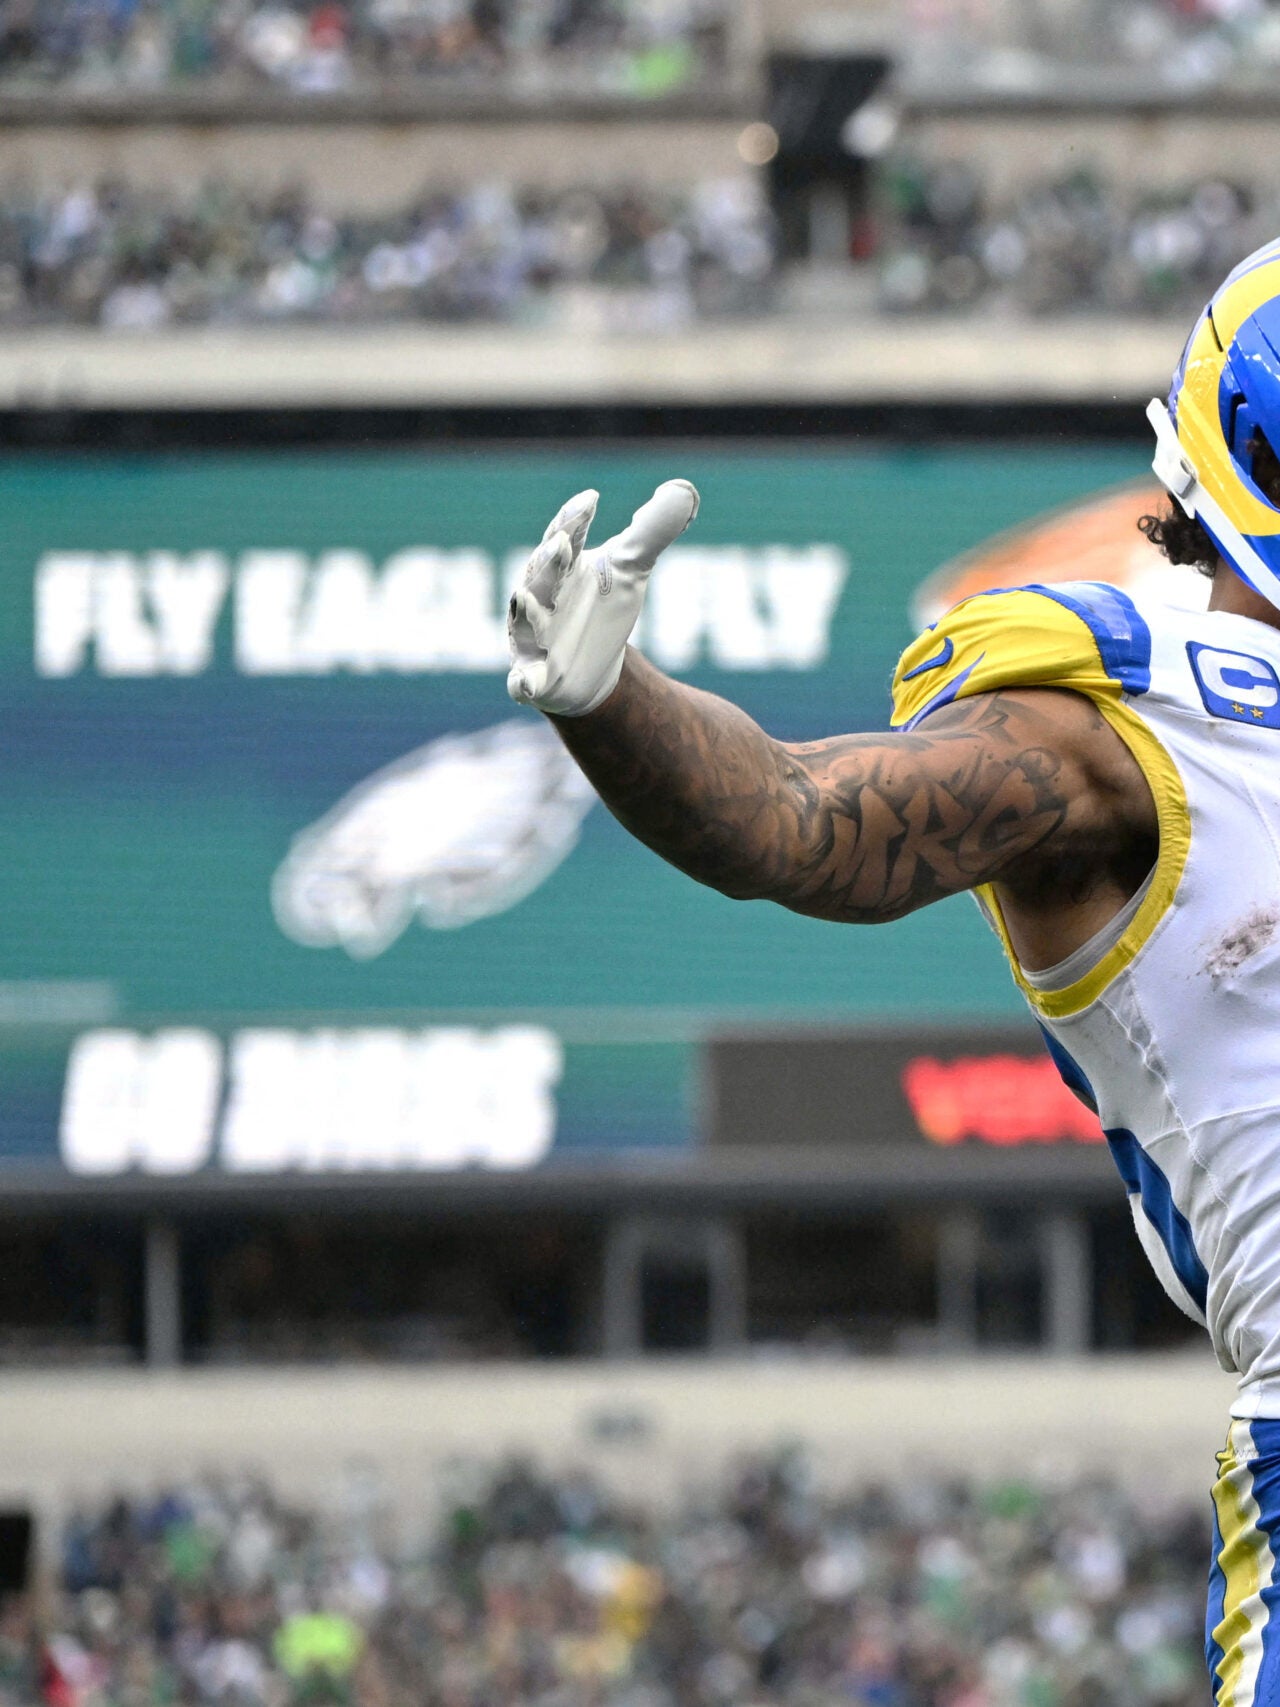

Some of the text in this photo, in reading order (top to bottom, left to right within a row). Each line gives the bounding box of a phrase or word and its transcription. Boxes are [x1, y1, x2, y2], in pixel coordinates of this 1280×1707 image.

[33, 545, 849, 676] FLY EAGL FLY
[1196, 648, 1279, 708] C
